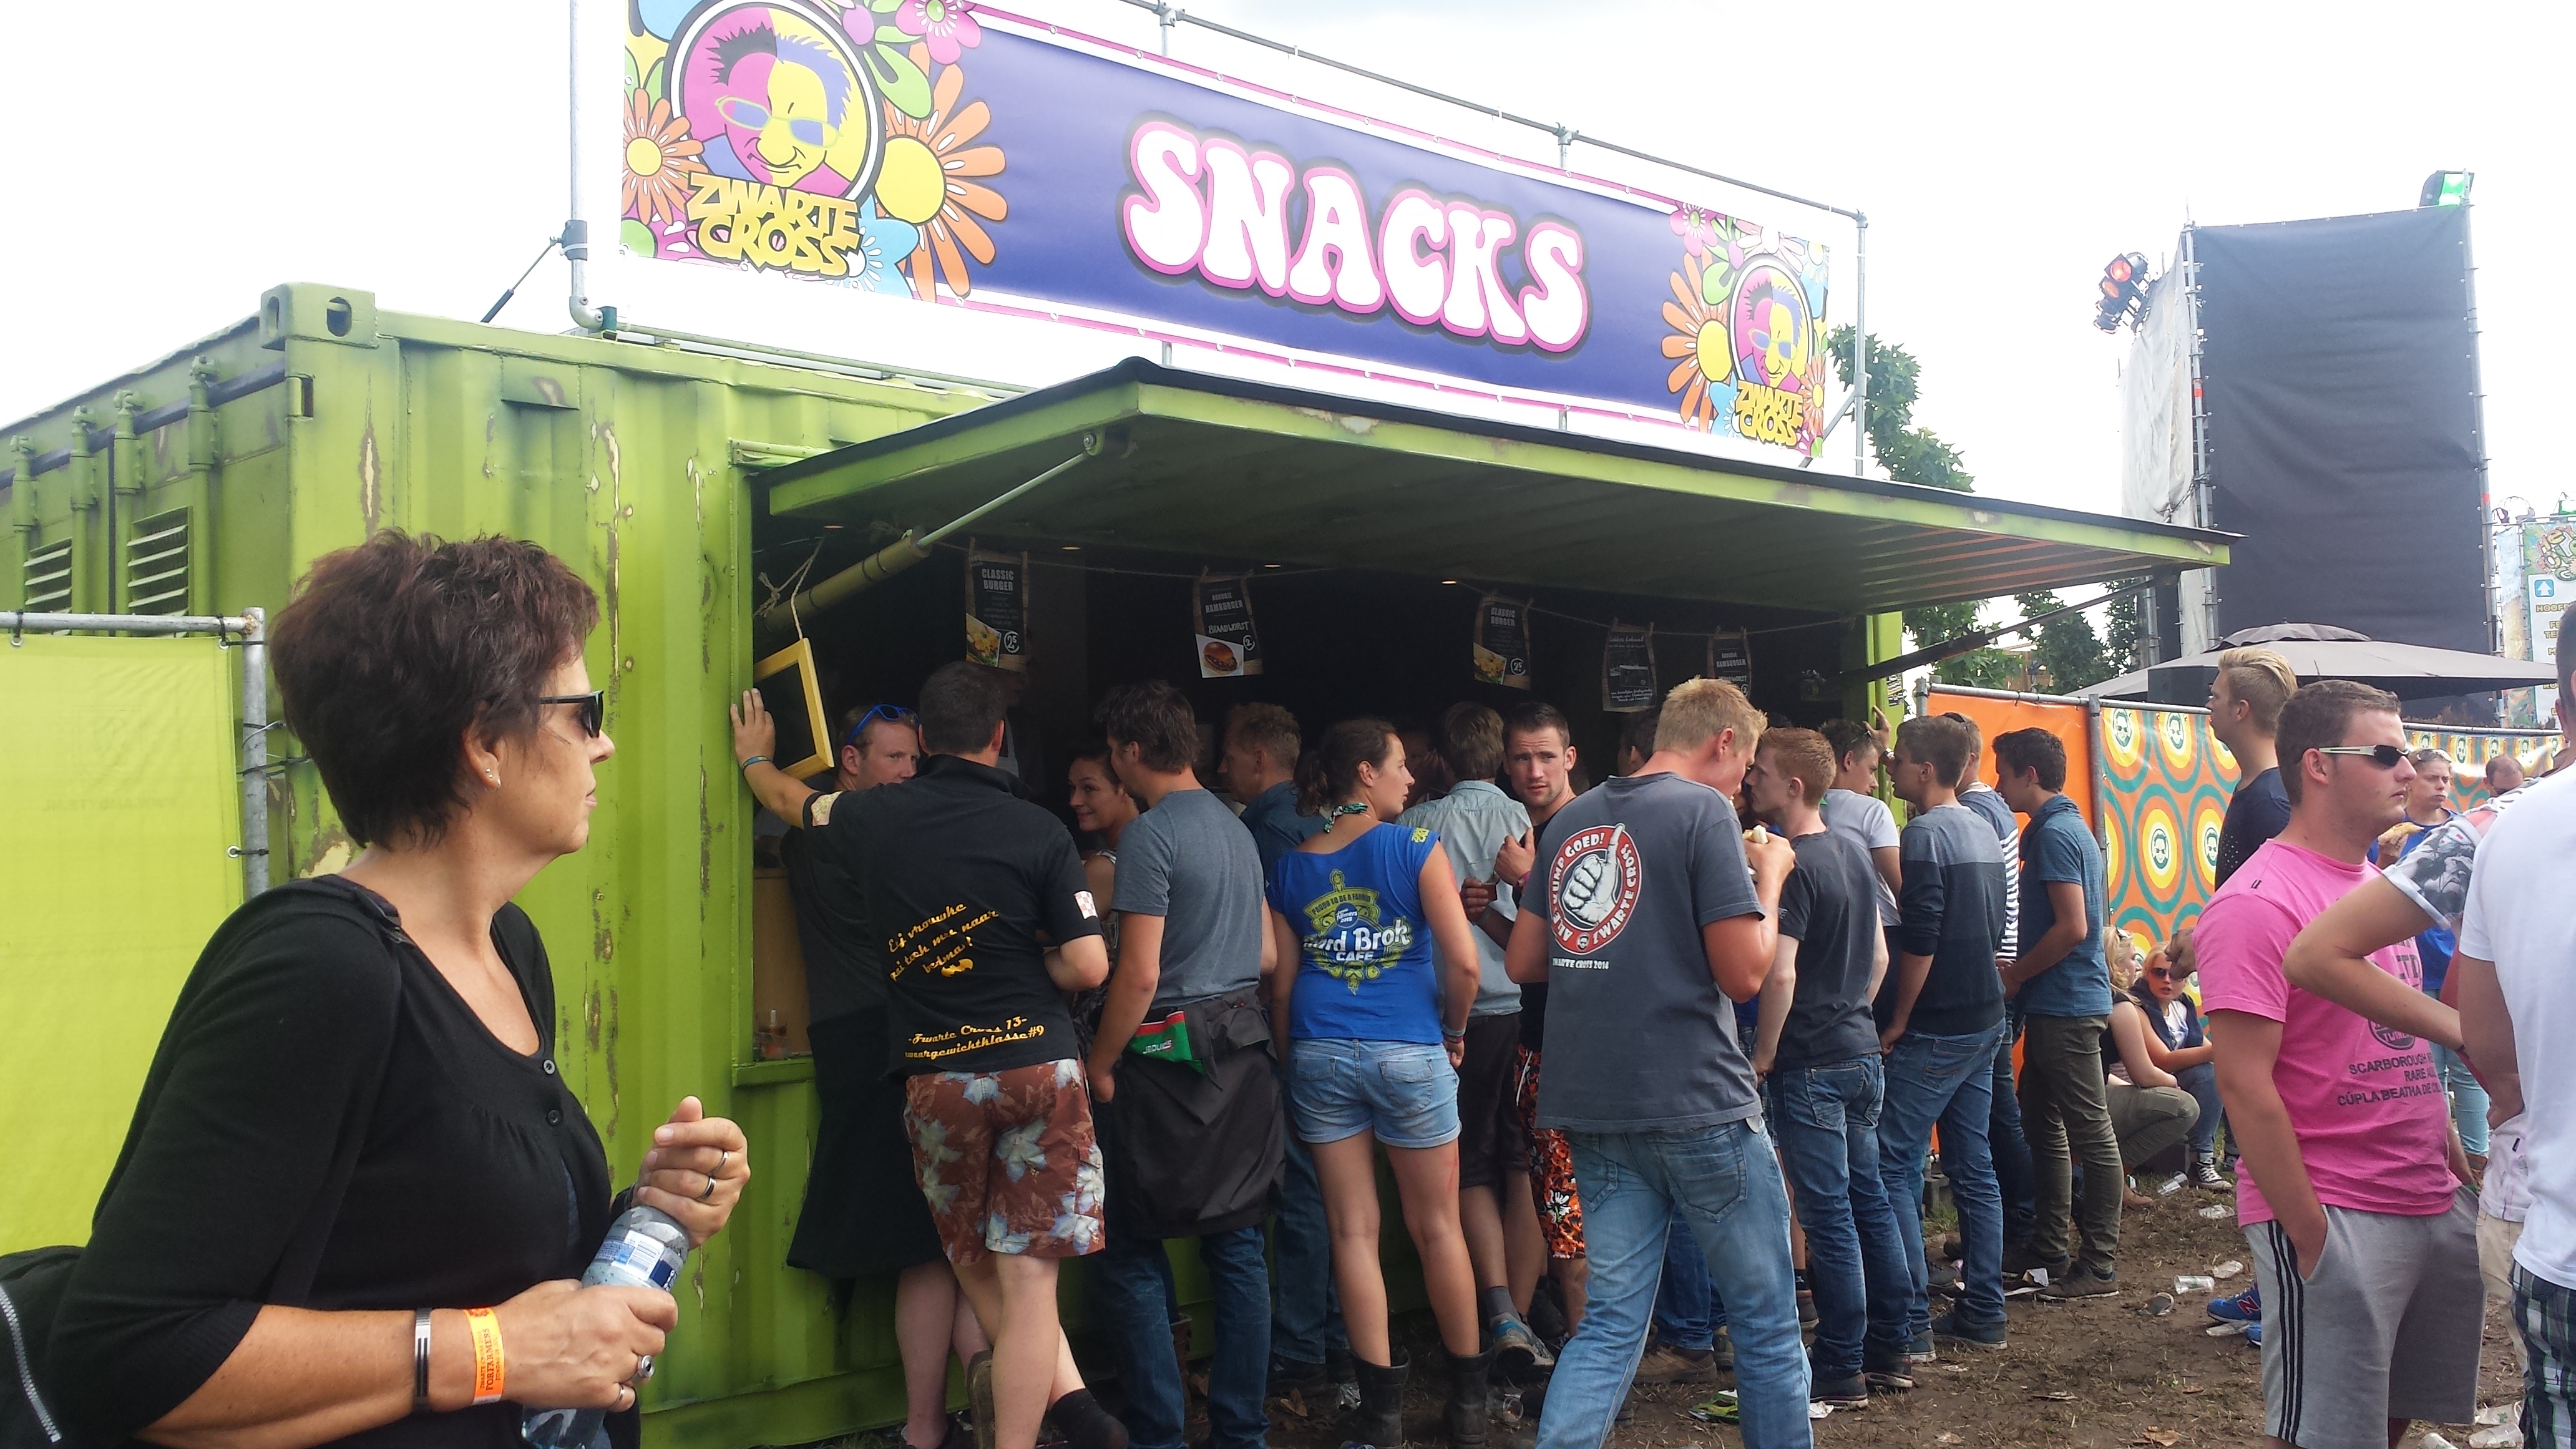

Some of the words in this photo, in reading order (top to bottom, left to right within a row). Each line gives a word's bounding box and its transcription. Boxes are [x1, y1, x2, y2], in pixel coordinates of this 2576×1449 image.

[688, 173, 862, 247] ZWARTE
[1125, 122, 1588, 353] SNACKS
[698, 216, 851, 278] CROSS
[1735, 379, 1804, 427] ZWARTE
[1739, 407, 1797, 447] CROSS
[982, 568, 1014, 580] CLASSIC
[983, 579, 1013, 591] BURGER
[1205, 600, 1243, 613] HAMBURGER
[1491, 607, 1516, 618] CLASSIC
[1491, 616, 1515, 627] BURGER
[1564, 832, 1605, 858] GOED!
[1593, 889, 1635, 945] ZWARTE
[1621, 843, 1637, 887] CROSS
[1311, 900, 1331, 915] PROUD
[961, 910, 998, 932] naar
[1336, 951, 1374, 961] CAFE
[1593, 960, 1609, 970] 2014
[2349, 1053, 2426, 1075] SCARBOROUGH
[2404, 1068, 2426, 1081] RARE
[2381, 1086, 2422, 1101] BEATHA
[483, 1329, 494, 1391] FORFARMERS
